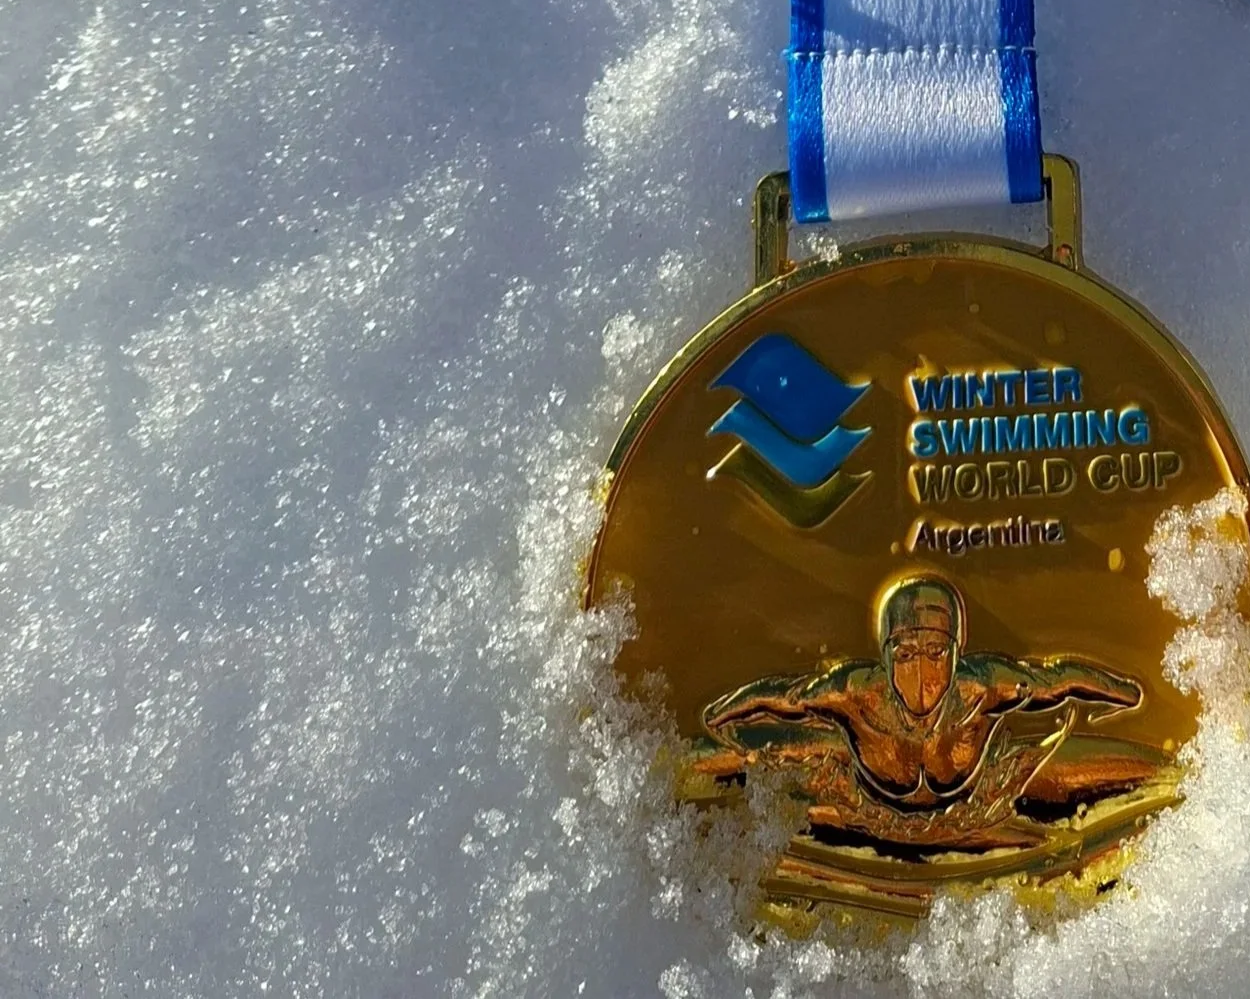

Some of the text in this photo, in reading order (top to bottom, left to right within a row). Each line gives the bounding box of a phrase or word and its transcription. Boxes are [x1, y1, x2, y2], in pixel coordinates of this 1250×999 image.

[909, 367, 1084, 412] WINTER
[911, 406, 1150, 458] SWIMMING
[909, 451, 1183, 503] WORLD CUP
[907, 516, 1066, 556] Argentina
